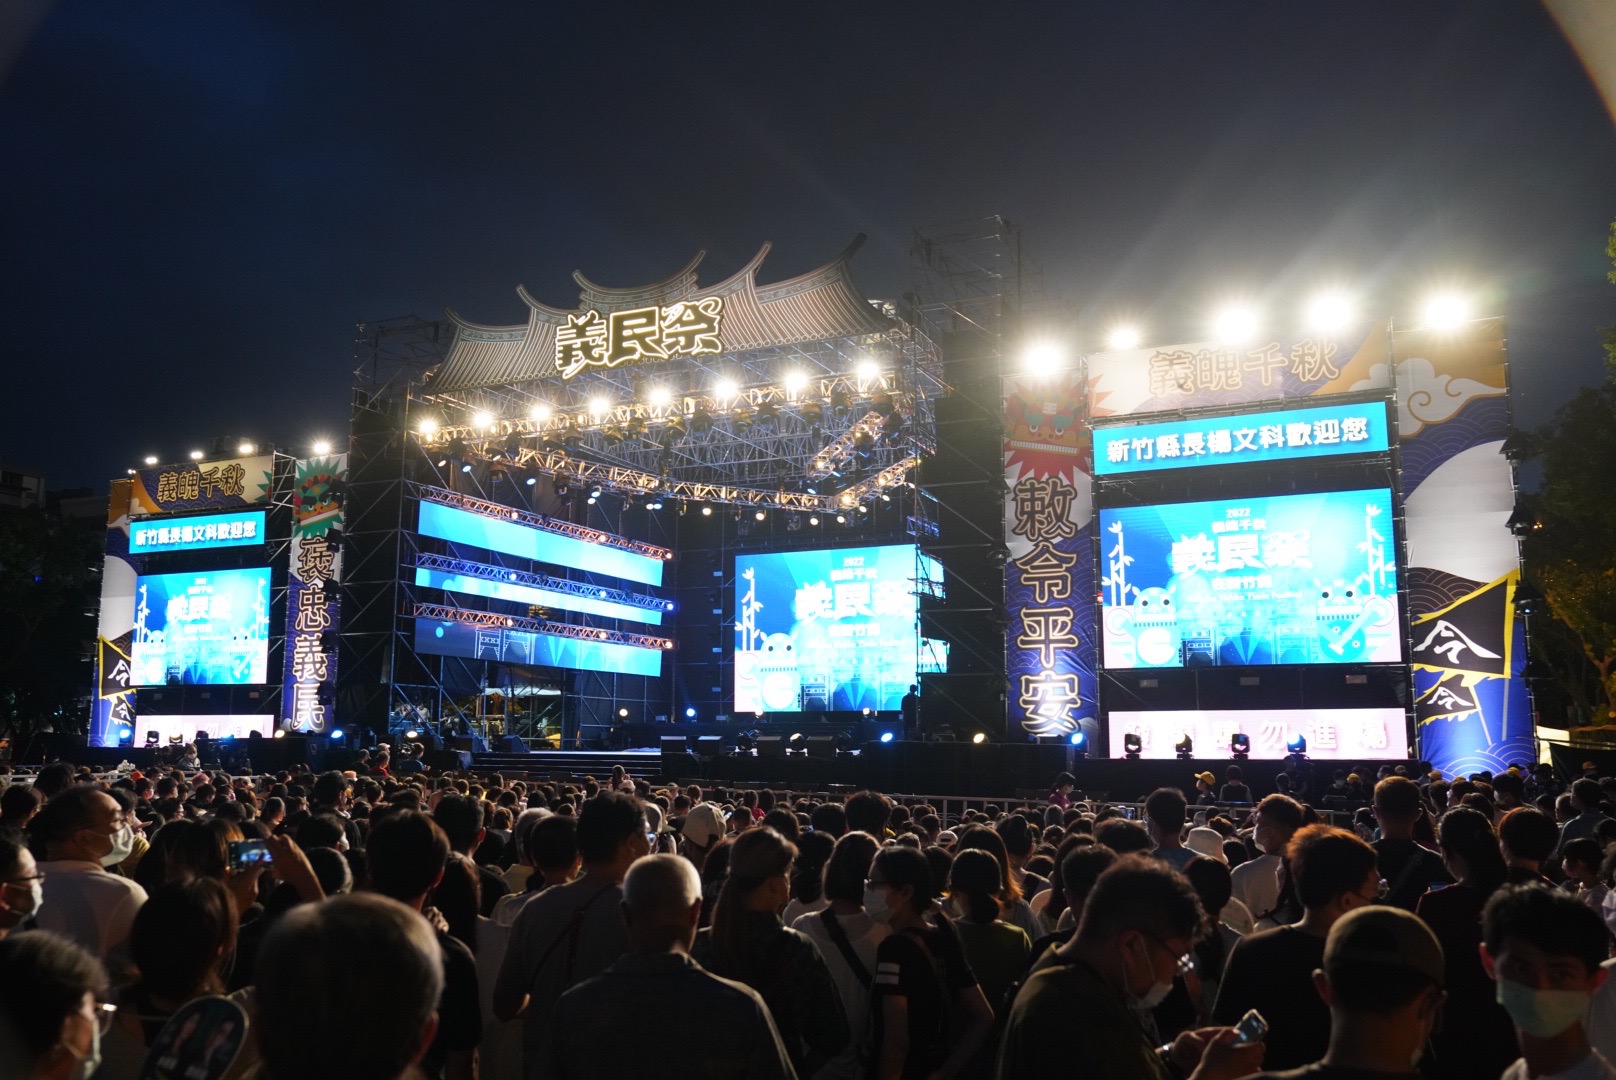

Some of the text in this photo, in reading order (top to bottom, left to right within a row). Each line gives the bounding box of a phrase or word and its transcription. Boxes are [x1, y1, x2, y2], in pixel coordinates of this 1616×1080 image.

[555, 296, 722, 380] 義民祭
[1150, 337, 1341, 398] 義魄千秋
[1106, 416, 1368, 462] 新竹縣長楊文科歡迎您
[157, 463, 245, 502] 義魄千秋
[292, 535, 335, 731] 褒忠義民
[1012, 477, 1081, 734] 敕令平安
[1413, 620, 1502, 664] 令
